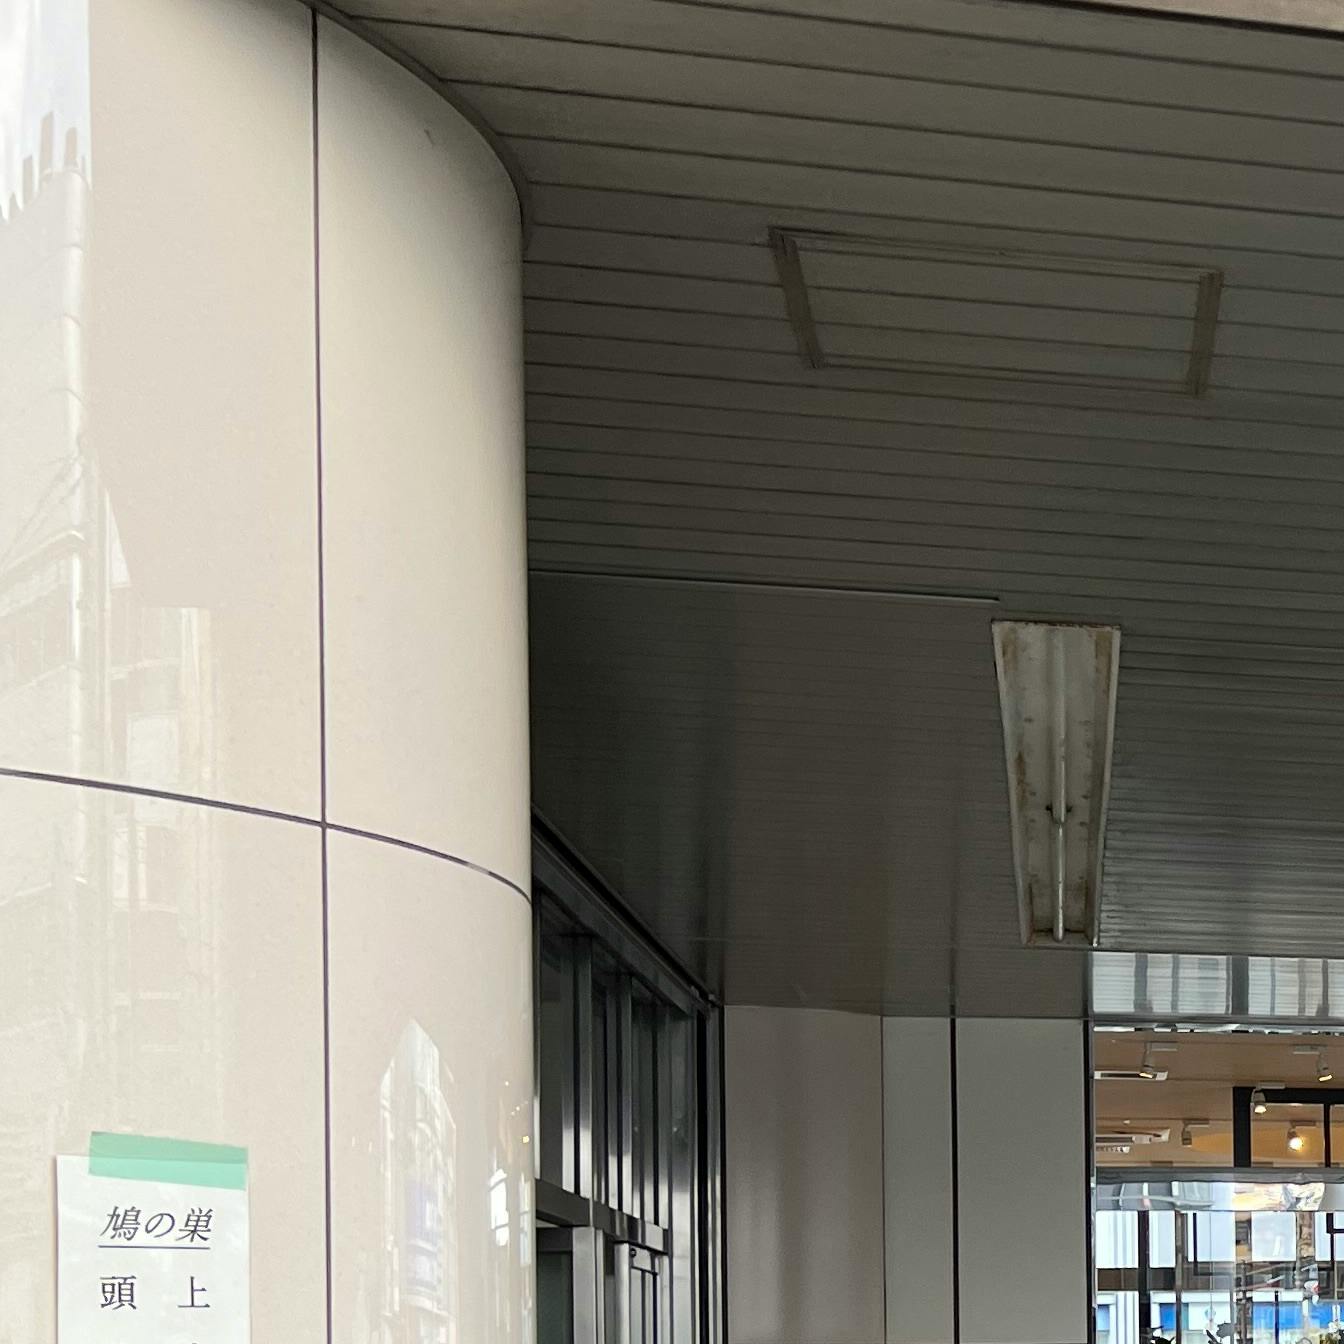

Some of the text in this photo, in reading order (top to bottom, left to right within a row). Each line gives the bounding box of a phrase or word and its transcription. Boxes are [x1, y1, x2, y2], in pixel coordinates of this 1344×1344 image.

[100, 1206, 214, 1243] 鳩の巣
[100, 1275, 211, 1311] 頭上
